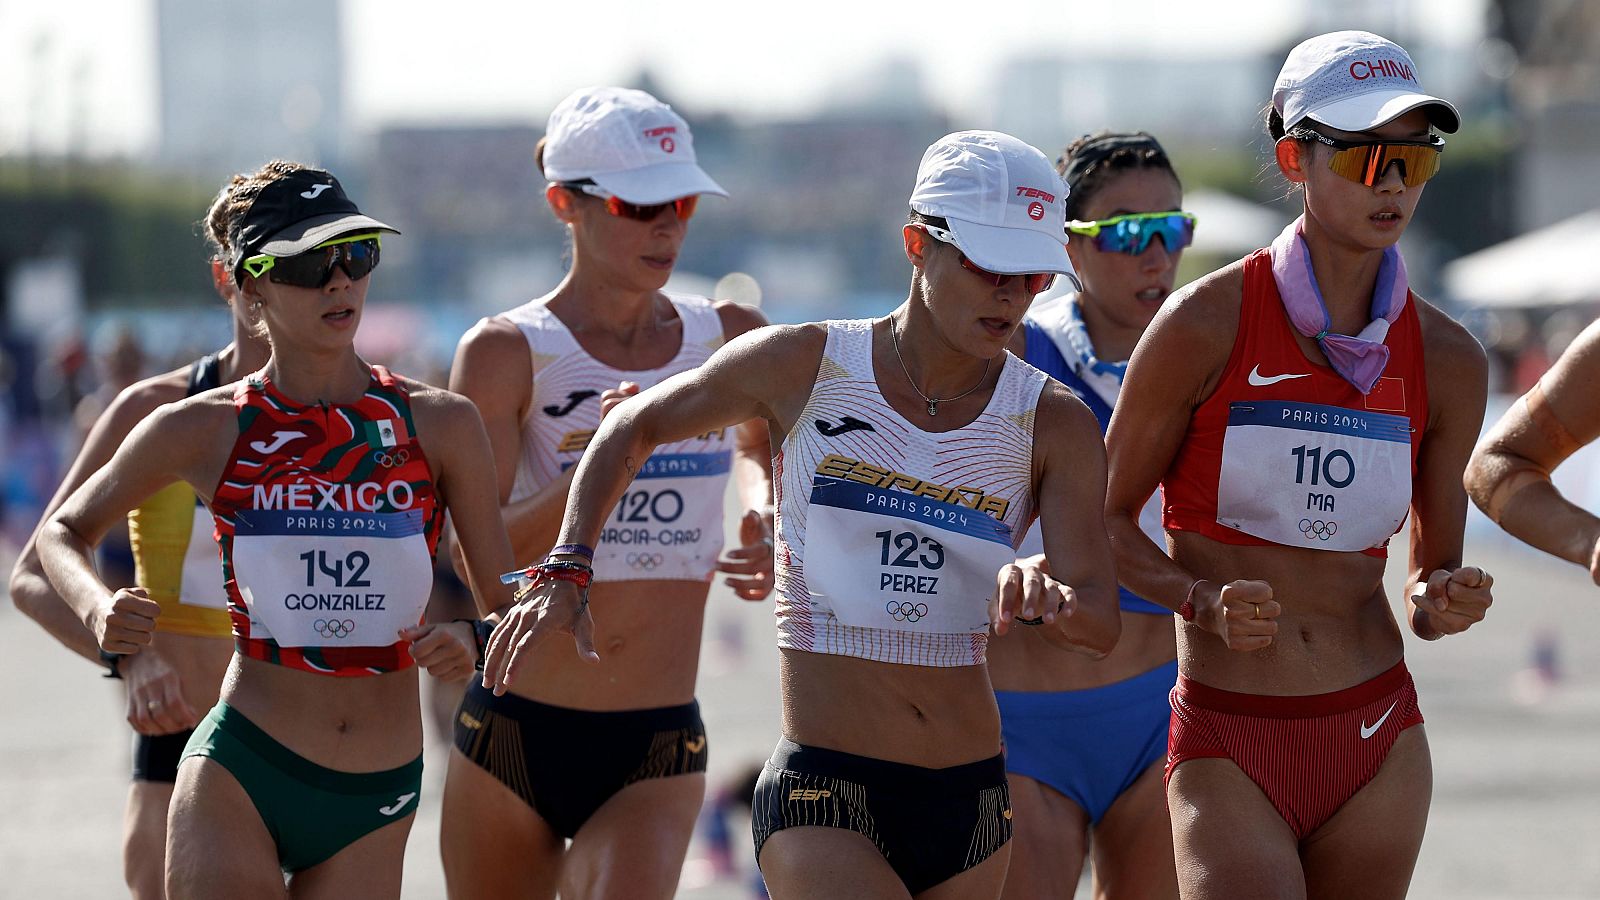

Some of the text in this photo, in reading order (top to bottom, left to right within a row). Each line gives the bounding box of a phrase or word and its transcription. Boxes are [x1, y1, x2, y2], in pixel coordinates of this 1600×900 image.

[1349, 59, 1418, 84] CHINA
[1016, 186, 1056, 204] TEAM
[1333, 415, 1367, 431] 2024
[1291, 444, 1356, 489] 110
[252, 477, 414, 512] MÉXICO
[616, 488, 684, 523] 120
[1306, 492, 1336, 513] MA
[342, 518, 388, 532] 2024
[923, 505, 969, 528] 2024
[875, 529, 945, 570] 123
[300, 549, 371, 588] 142
[880, 573, 939, 595] PEREZ
[284, 592, 386, 611] GONZALEZ
[789, 789, 832, 801] ESP
